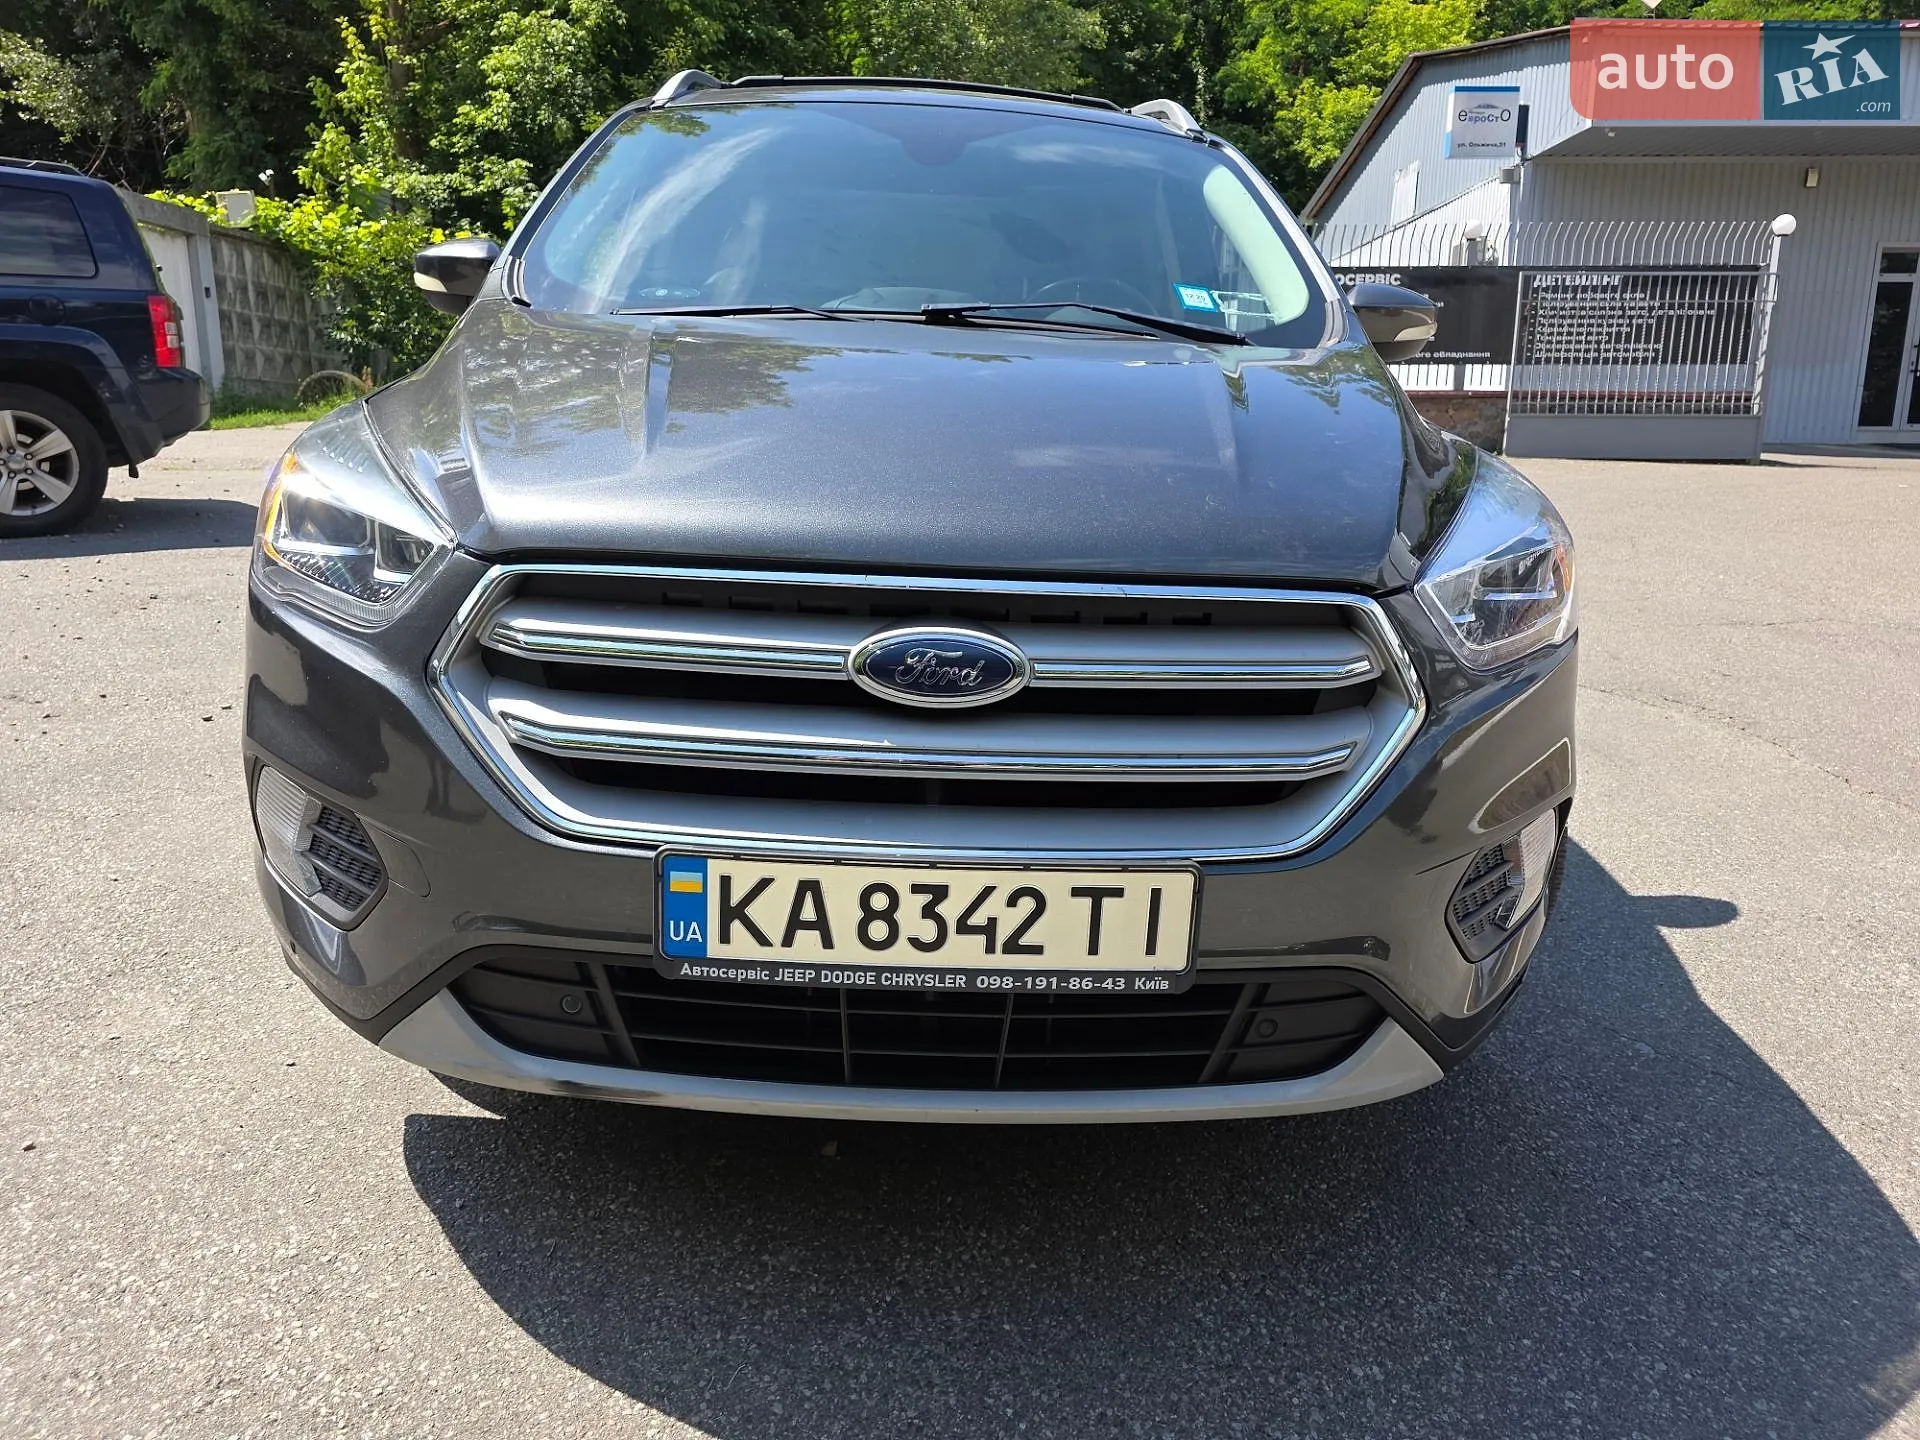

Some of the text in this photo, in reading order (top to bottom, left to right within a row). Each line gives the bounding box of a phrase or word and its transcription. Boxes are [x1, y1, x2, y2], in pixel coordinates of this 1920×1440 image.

[896, 647, 986, 687] Ford
[669, 919, 703, 943] UA
[857, 882, 1047, 954] 8342
[680, 962, 1169, 991] Автосервіс JEEP DODGE CHRYSLER 098-191-86-43 Київ
